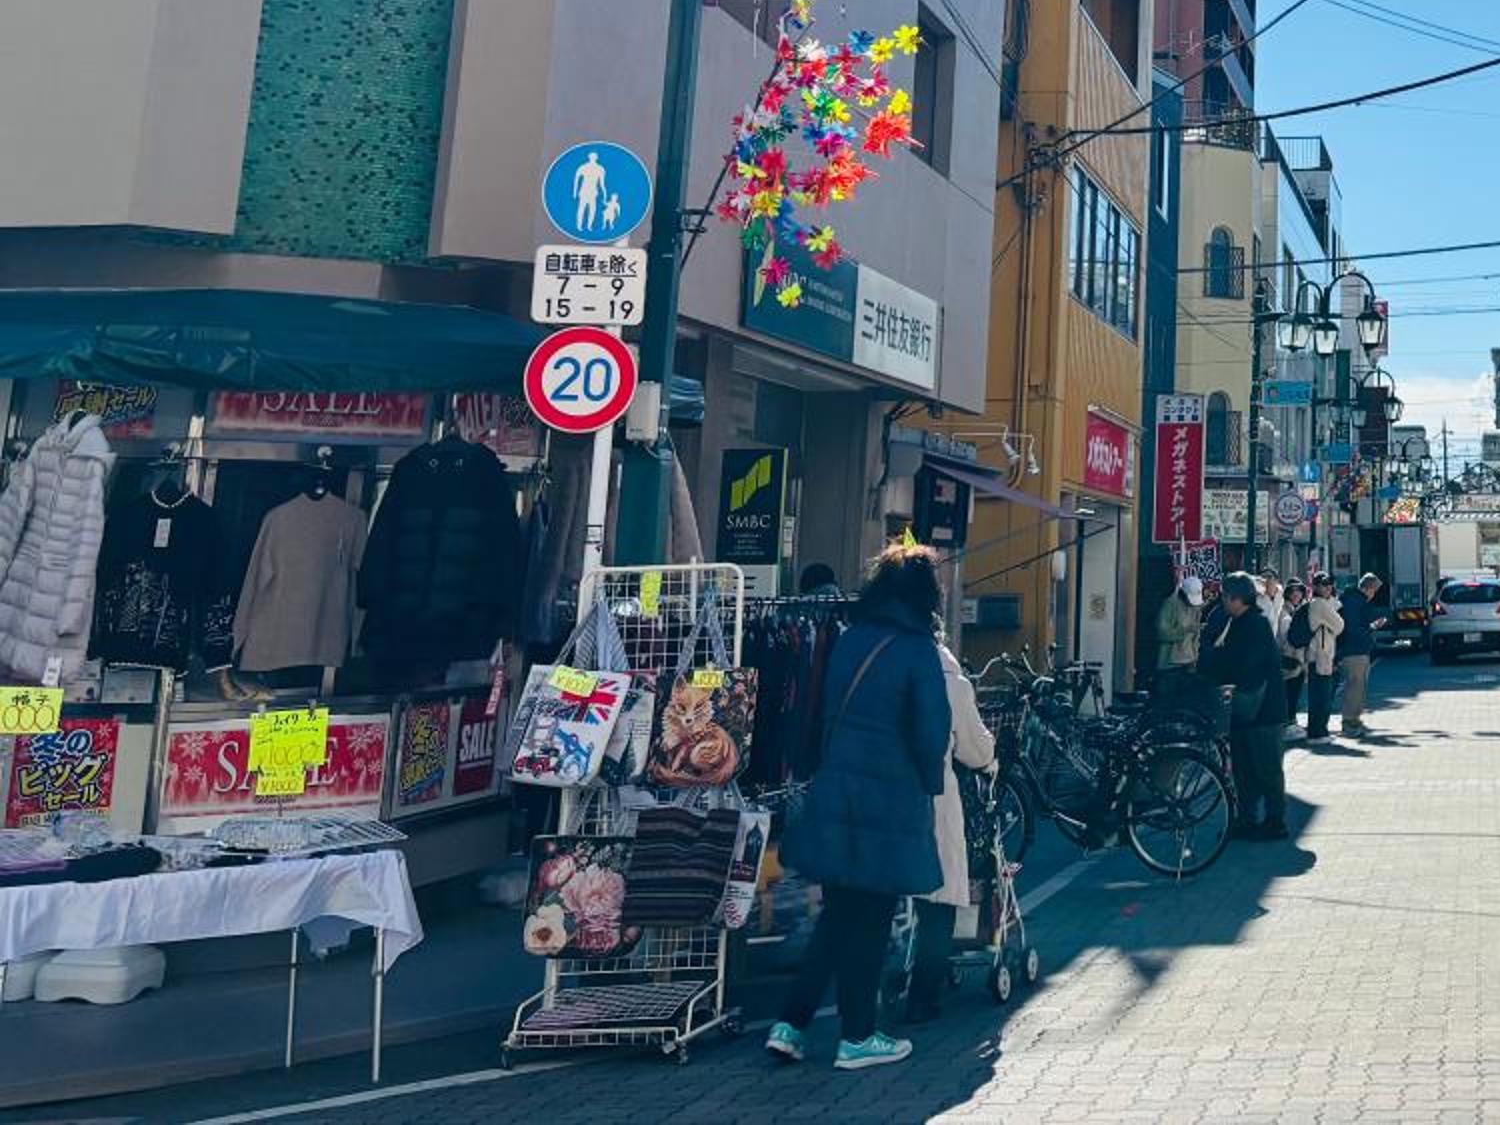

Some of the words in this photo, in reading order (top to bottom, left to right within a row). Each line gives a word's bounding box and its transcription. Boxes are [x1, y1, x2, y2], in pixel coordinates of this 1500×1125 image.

[545, 253, 638, 275] 自転車を除く
[860, 297, 932, 363] 三井住友銀行
[550, 356, 612, 402] 20
[726, 513, 771, 530] SMBC
[31, 729, 92, 765] 冬の
[458, 720, 497, 763] SALE
[18, 755, 109, 797] ビッグ
[47, 786, 100, 810] セール
